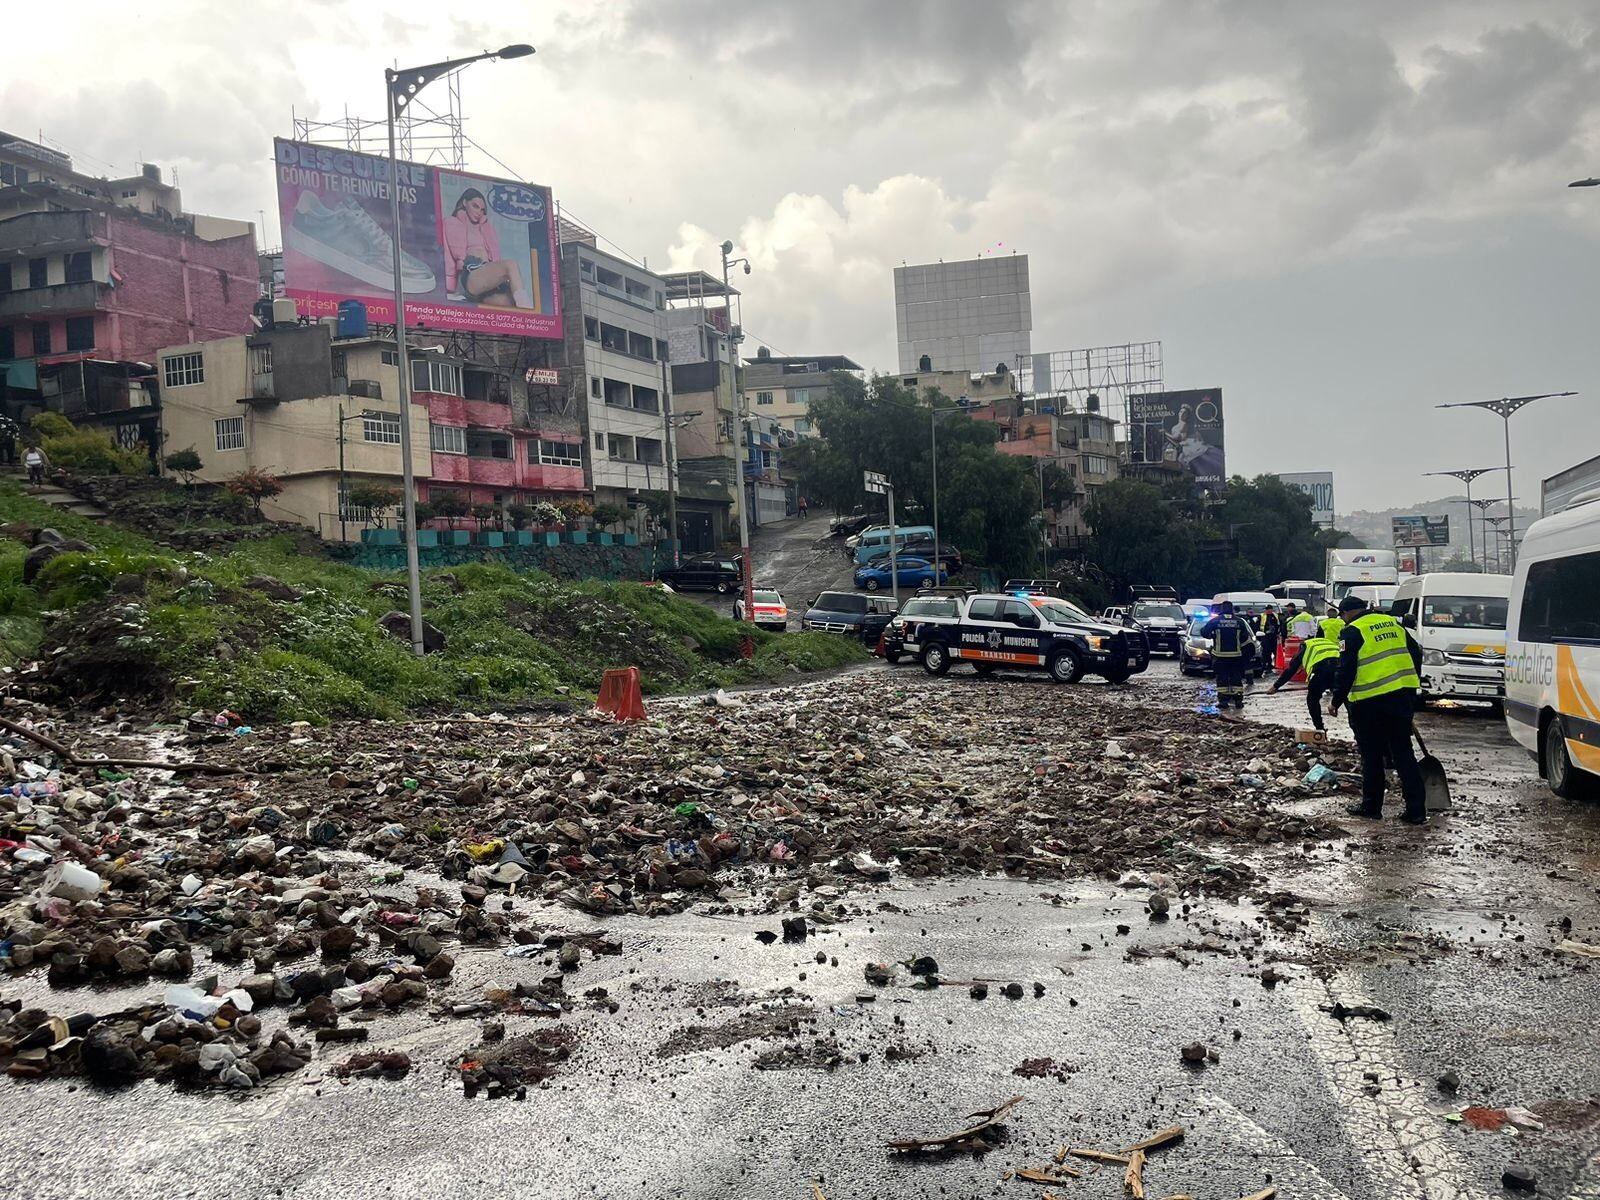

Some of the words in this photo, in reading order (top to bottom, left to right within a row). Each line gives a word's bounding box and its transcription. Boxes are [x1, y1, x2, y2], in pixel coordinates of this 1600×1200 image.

[275, 142, 425, 187] DESCUBRE
[281, 164, 320, 188] CÓMO
[321, 173, 339, 192] TE
[341, 177, 417, 204] REINVENTAS
[405, 304, 434, 314] Tienda
[436, 308, 464, 318] Vallejo:
[465, 311, 485, 320] Norte
[524, 317, 556, 326] Industrial
[416, 311, 441, 322] Vallejo
[490, 320, 516, 329] Ciudad
[526, 323, 549, 332] México
[1195, 401, 1219, 423] Q
[1003, 636, 1039, 647] MUNICIPAL
[1374, 631, 1399, 642] ESTATAL
